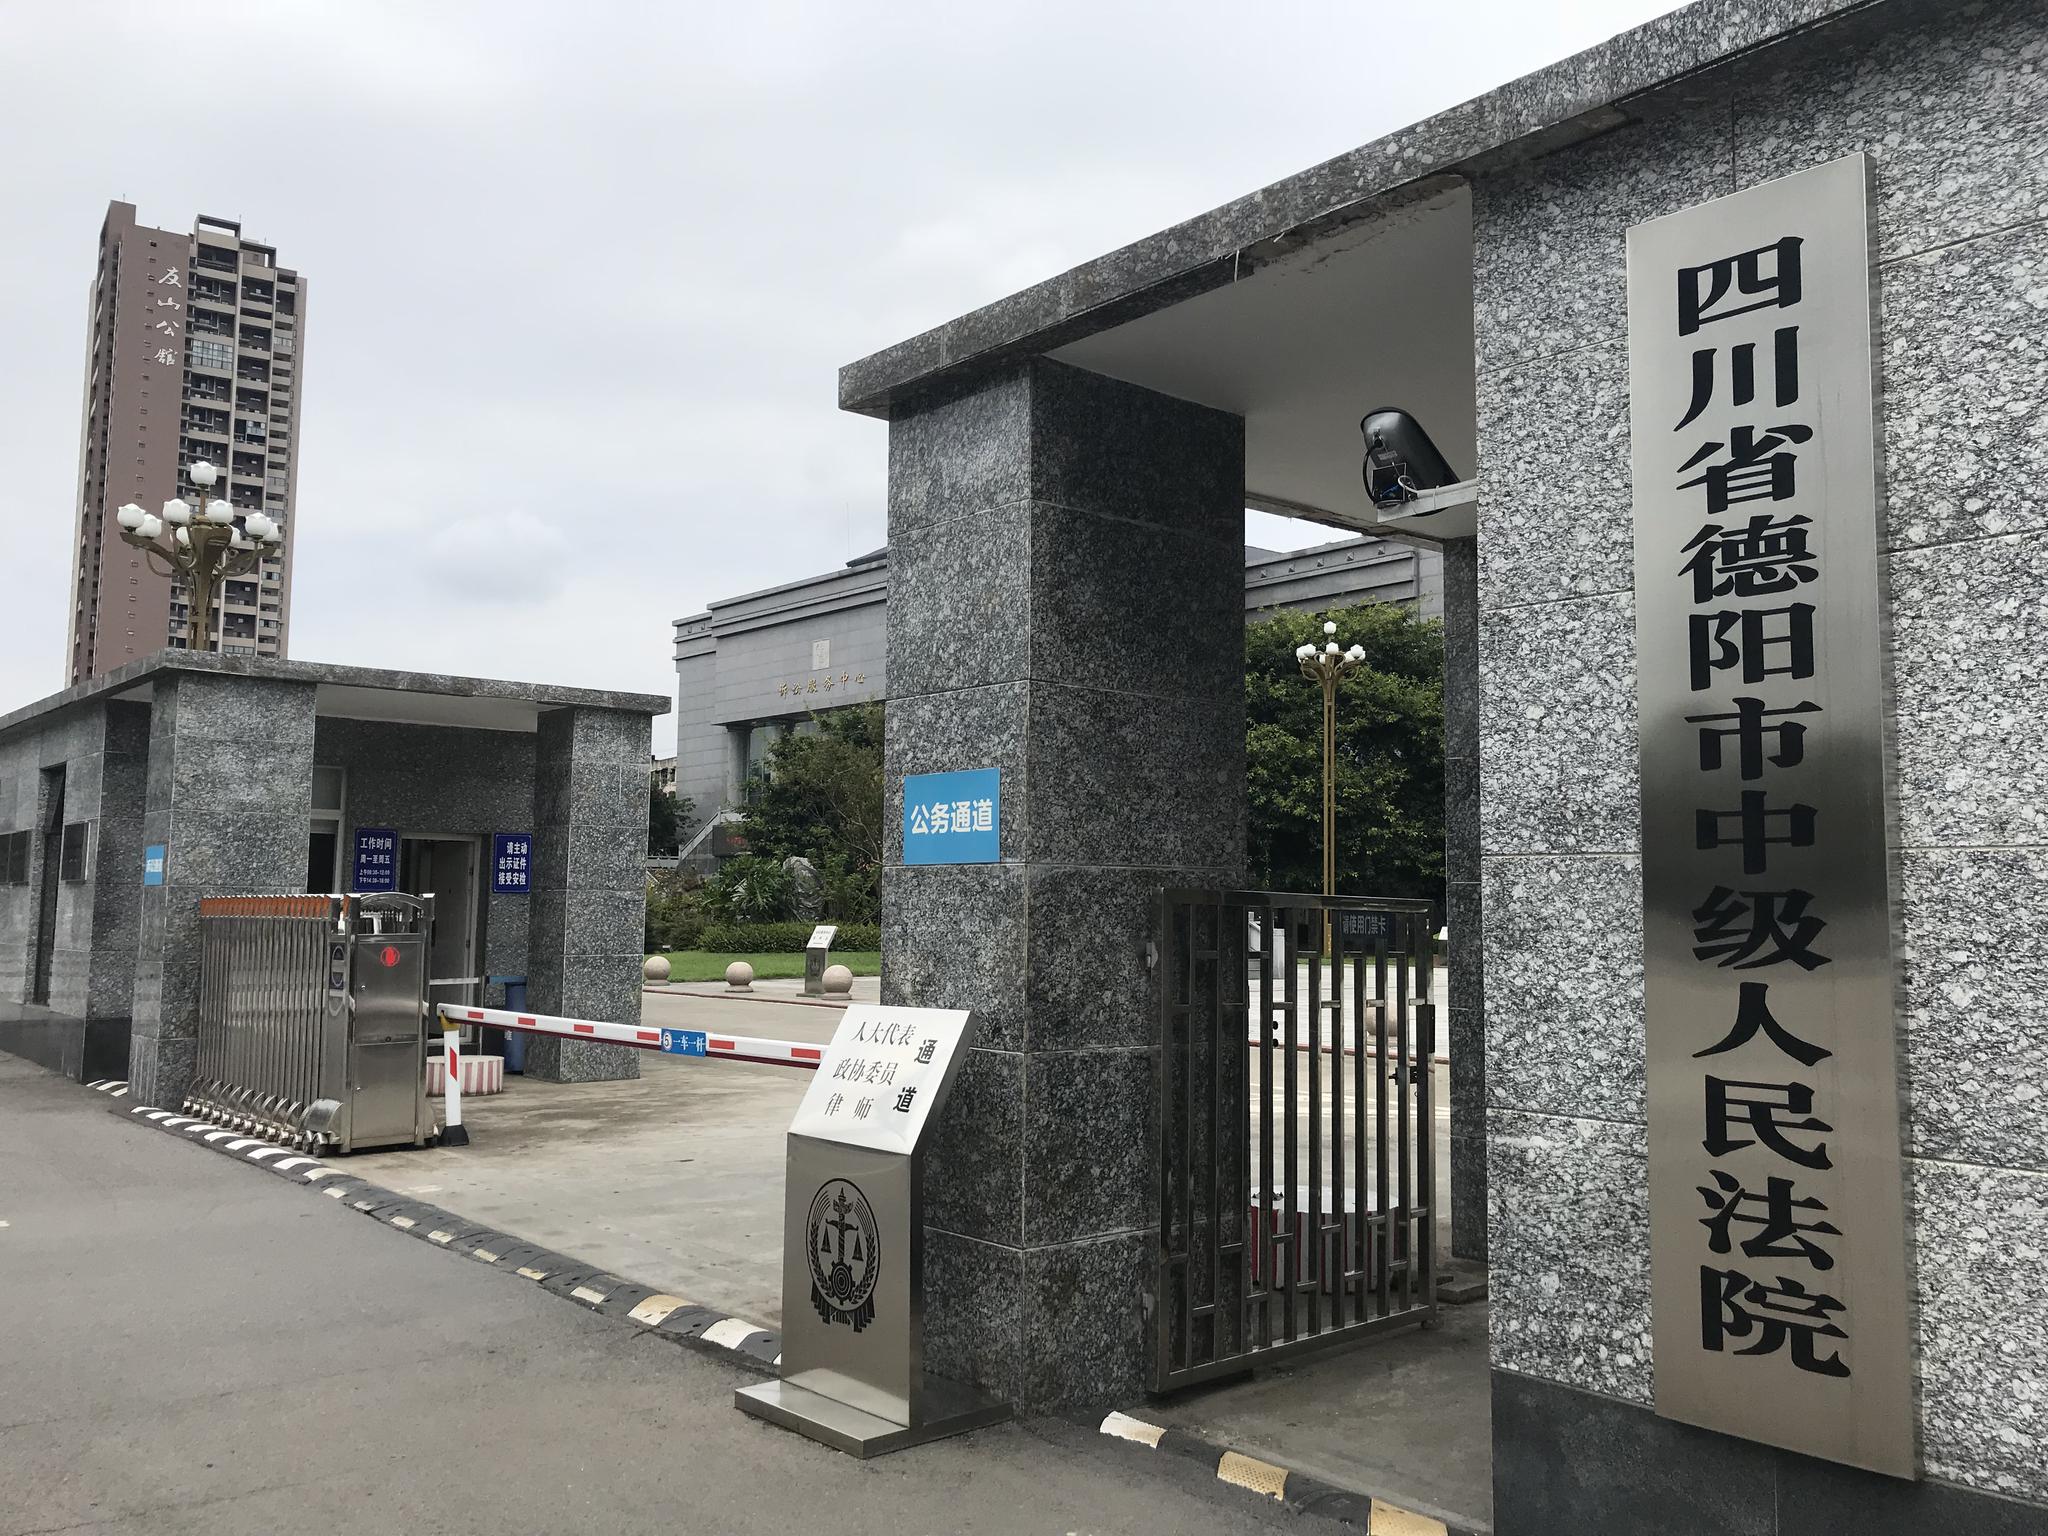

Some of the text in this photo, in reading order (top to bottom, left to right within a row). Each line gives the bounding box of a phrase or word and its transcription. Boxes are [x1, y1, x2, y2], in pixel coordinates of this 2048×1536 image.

[154, 266, 181, 366] 友山公馆
[911, 799, 992, 834] 公务通道
[1673, 236, 1850, 1378] 四川省德阳市中级人民法院
[360, 837, 392, 850] 工作时间
[506, 842, 528, 855] 请主动
[360, 854, 390, 864] 周一至周五
[499, 857, 527, 870] 出示证件
[498, 872, 526, 885] 接受安检
[851, 1021, 917, 1046] 人大代表
[833, 1057, 899, 1086] 政协委员
[824, 1092, 874, 1121] 律师
